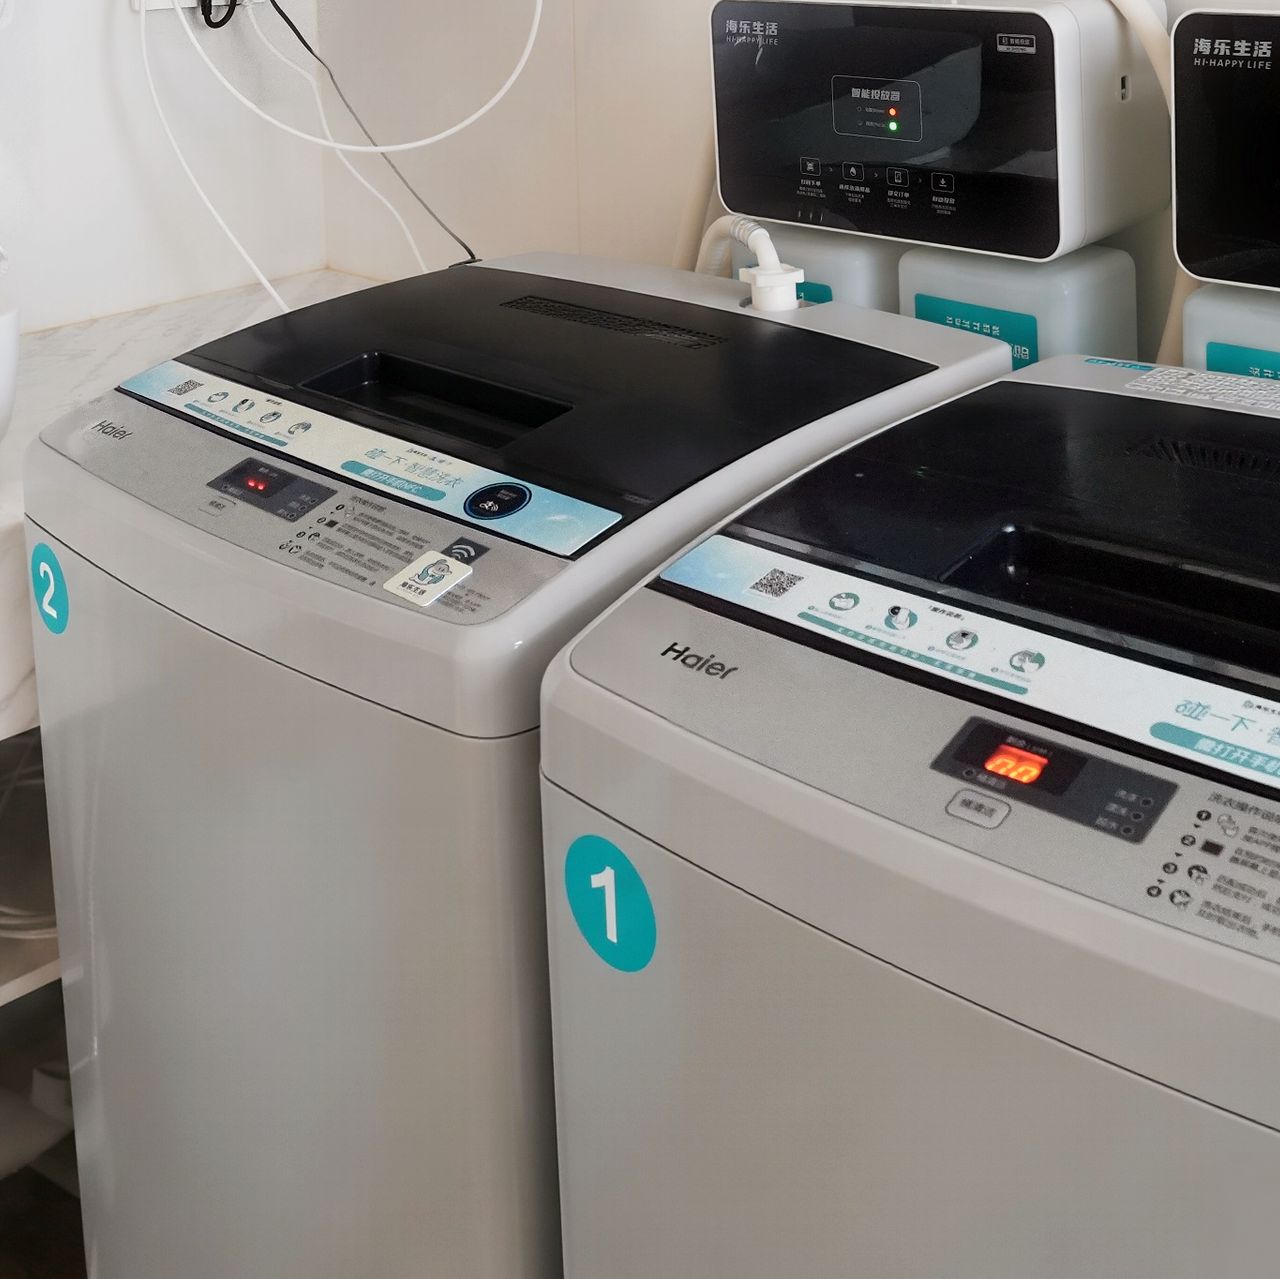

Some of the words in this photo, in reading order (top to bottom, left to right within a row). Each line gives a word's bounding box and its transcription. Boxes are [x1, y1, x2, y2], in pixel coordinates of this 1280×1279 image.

[725, 19, 779, 36] 海乐生活
[1192, 38, 1273, 58] 海乐生活
[1247, 60, 1272, 70] LIFE
[851, 87, 901, 102] 智能投放器
[91, 419, 134, 441] Haier
[38, 562, 59, 620] 2
[660, 641, 739, 681] Haier
[589, 865, 618, 944] 1
